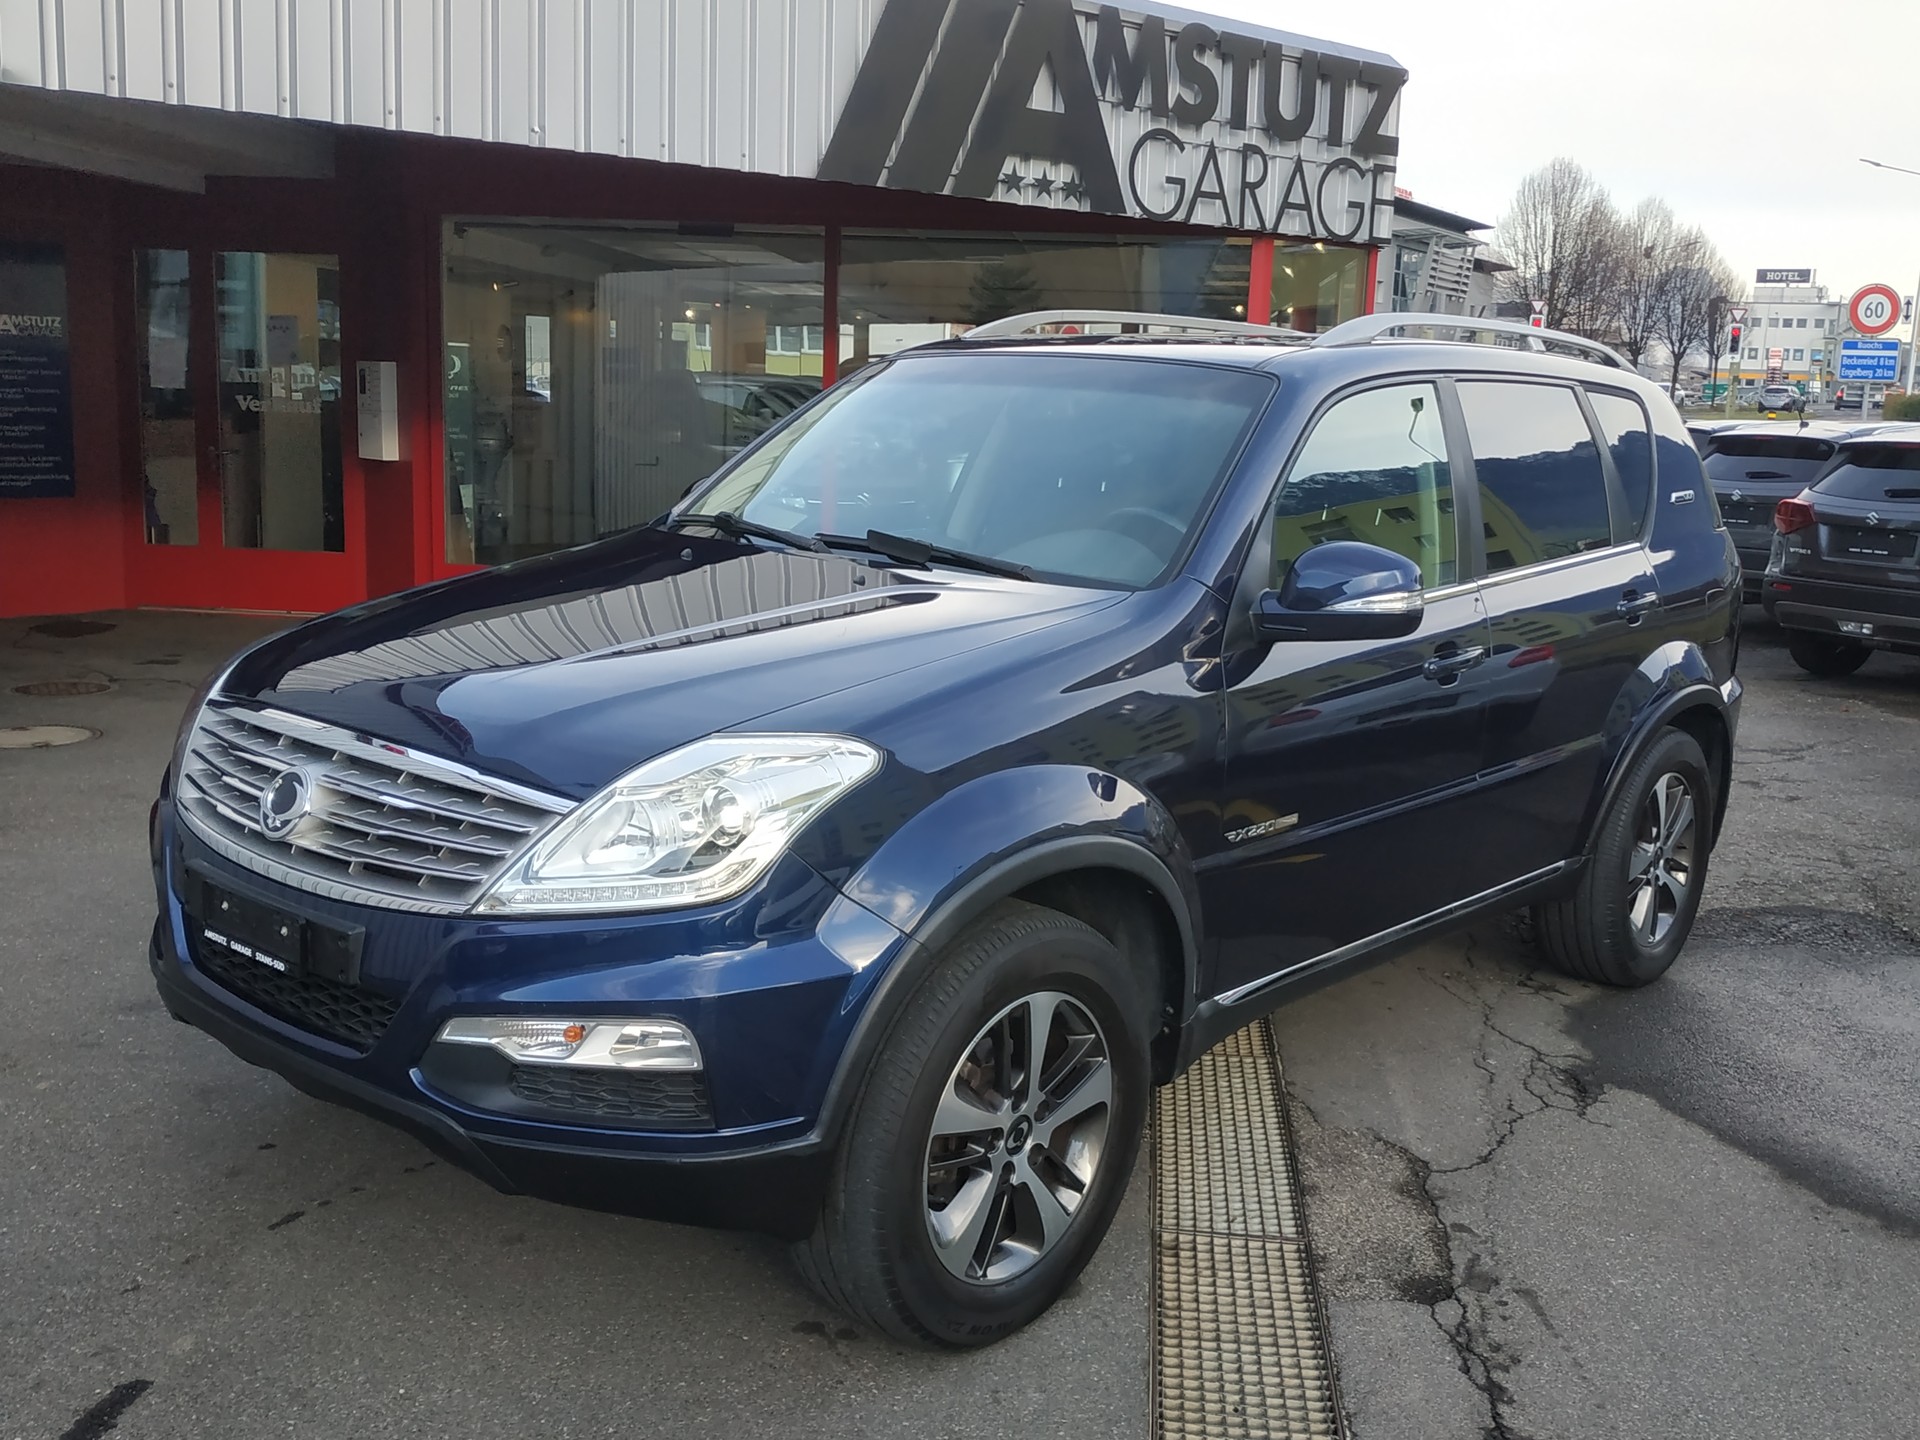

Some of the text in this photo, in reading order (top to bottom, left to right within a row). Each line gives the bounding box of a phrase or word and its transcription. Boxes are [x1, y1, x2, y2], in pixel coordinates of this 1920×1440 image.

[945, 0, 1399, 214] AMSTUTZ
[1128, 127, 1397, 245] GARAGE
[1766, 271, 1801, 281] HOTEL
[1864, 301, 1885, 319] 60
[16, 325, 62, 337] GARAGE
[1842, 356, 1895, 366] Beckenried 8 km
[1841, 367, 1894, 379] Engelberg 20 km
[235, 395, 322, 414] Verauf
[204, 929, 228, 946] AMSTUTZ
[230, 940, 252, 957] GARAGE
